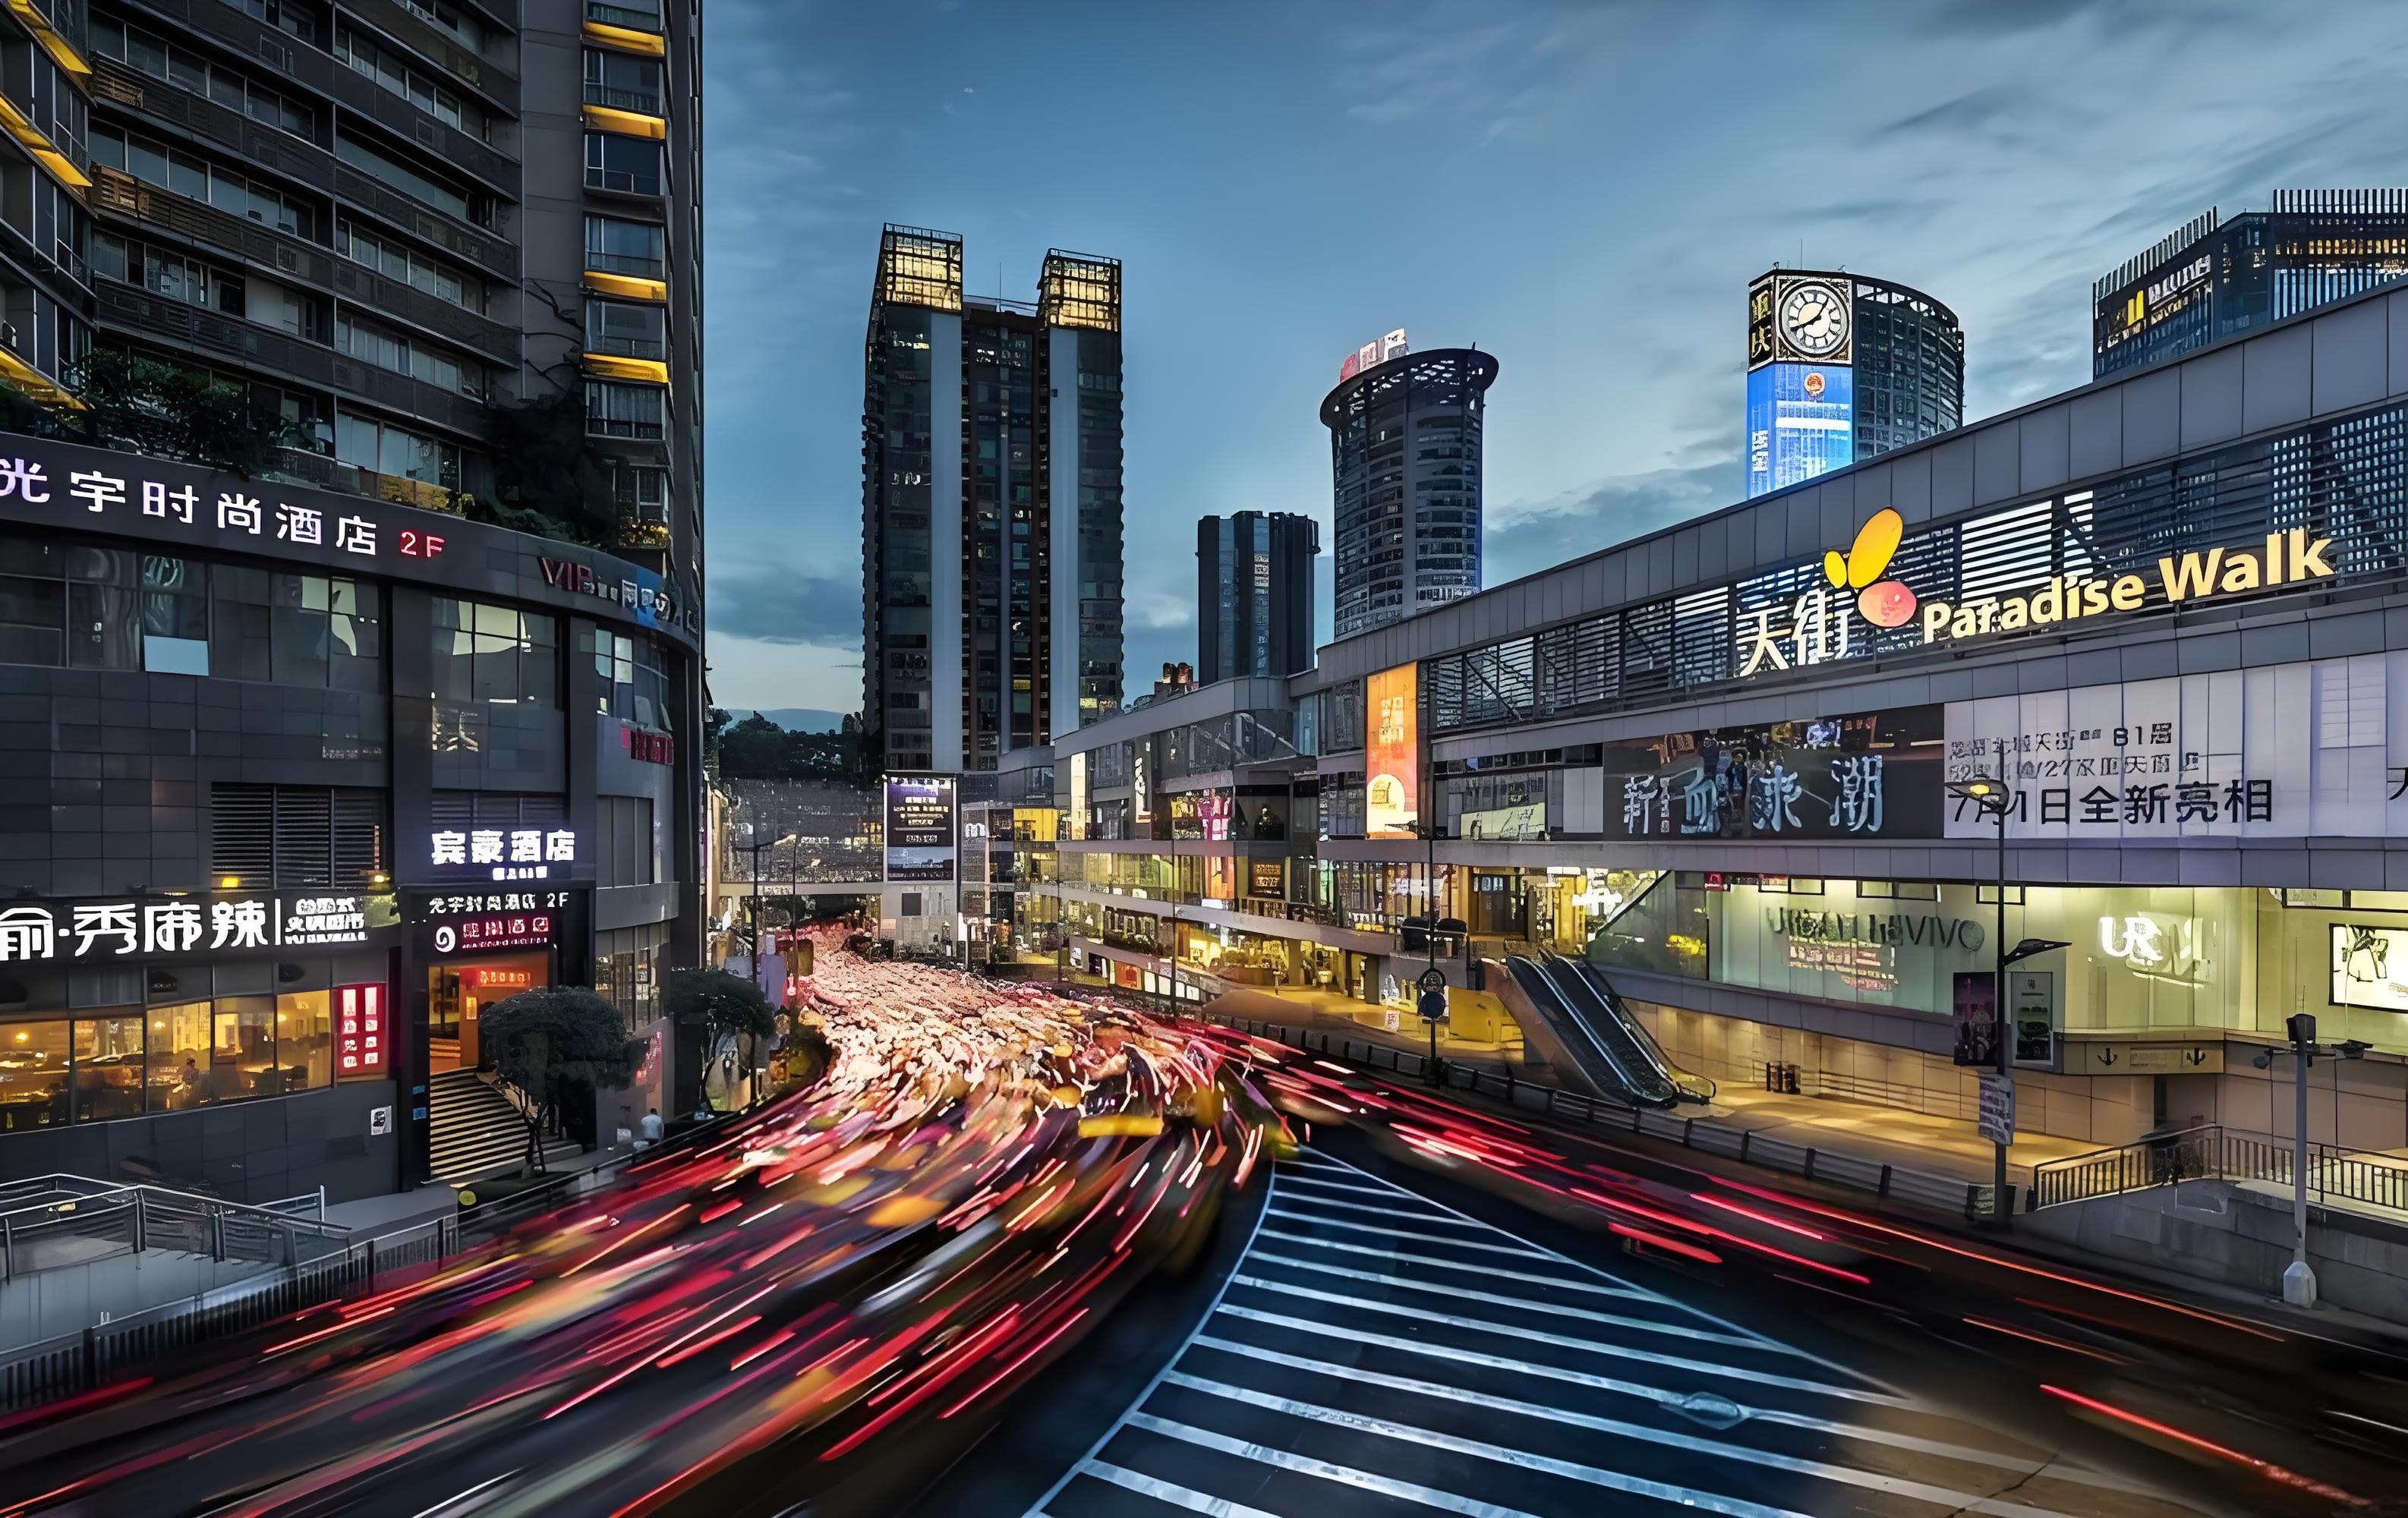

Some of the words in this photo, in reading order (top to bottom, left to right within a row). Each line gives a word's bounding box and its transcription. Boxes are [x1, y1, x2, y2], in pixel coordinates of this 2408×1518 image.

[0, 458, 377, 556] 光宇时尚酒店
[400, 528, 446, 558] 2F
[1922, 572, 2146, 644] Paradise
[2158, 529, 2337, 603] Walk
[1735, 588, 1855, 677] 天街
[546, 892, 570, 908] 2F
[2099, 917, 2164, 961] UR
